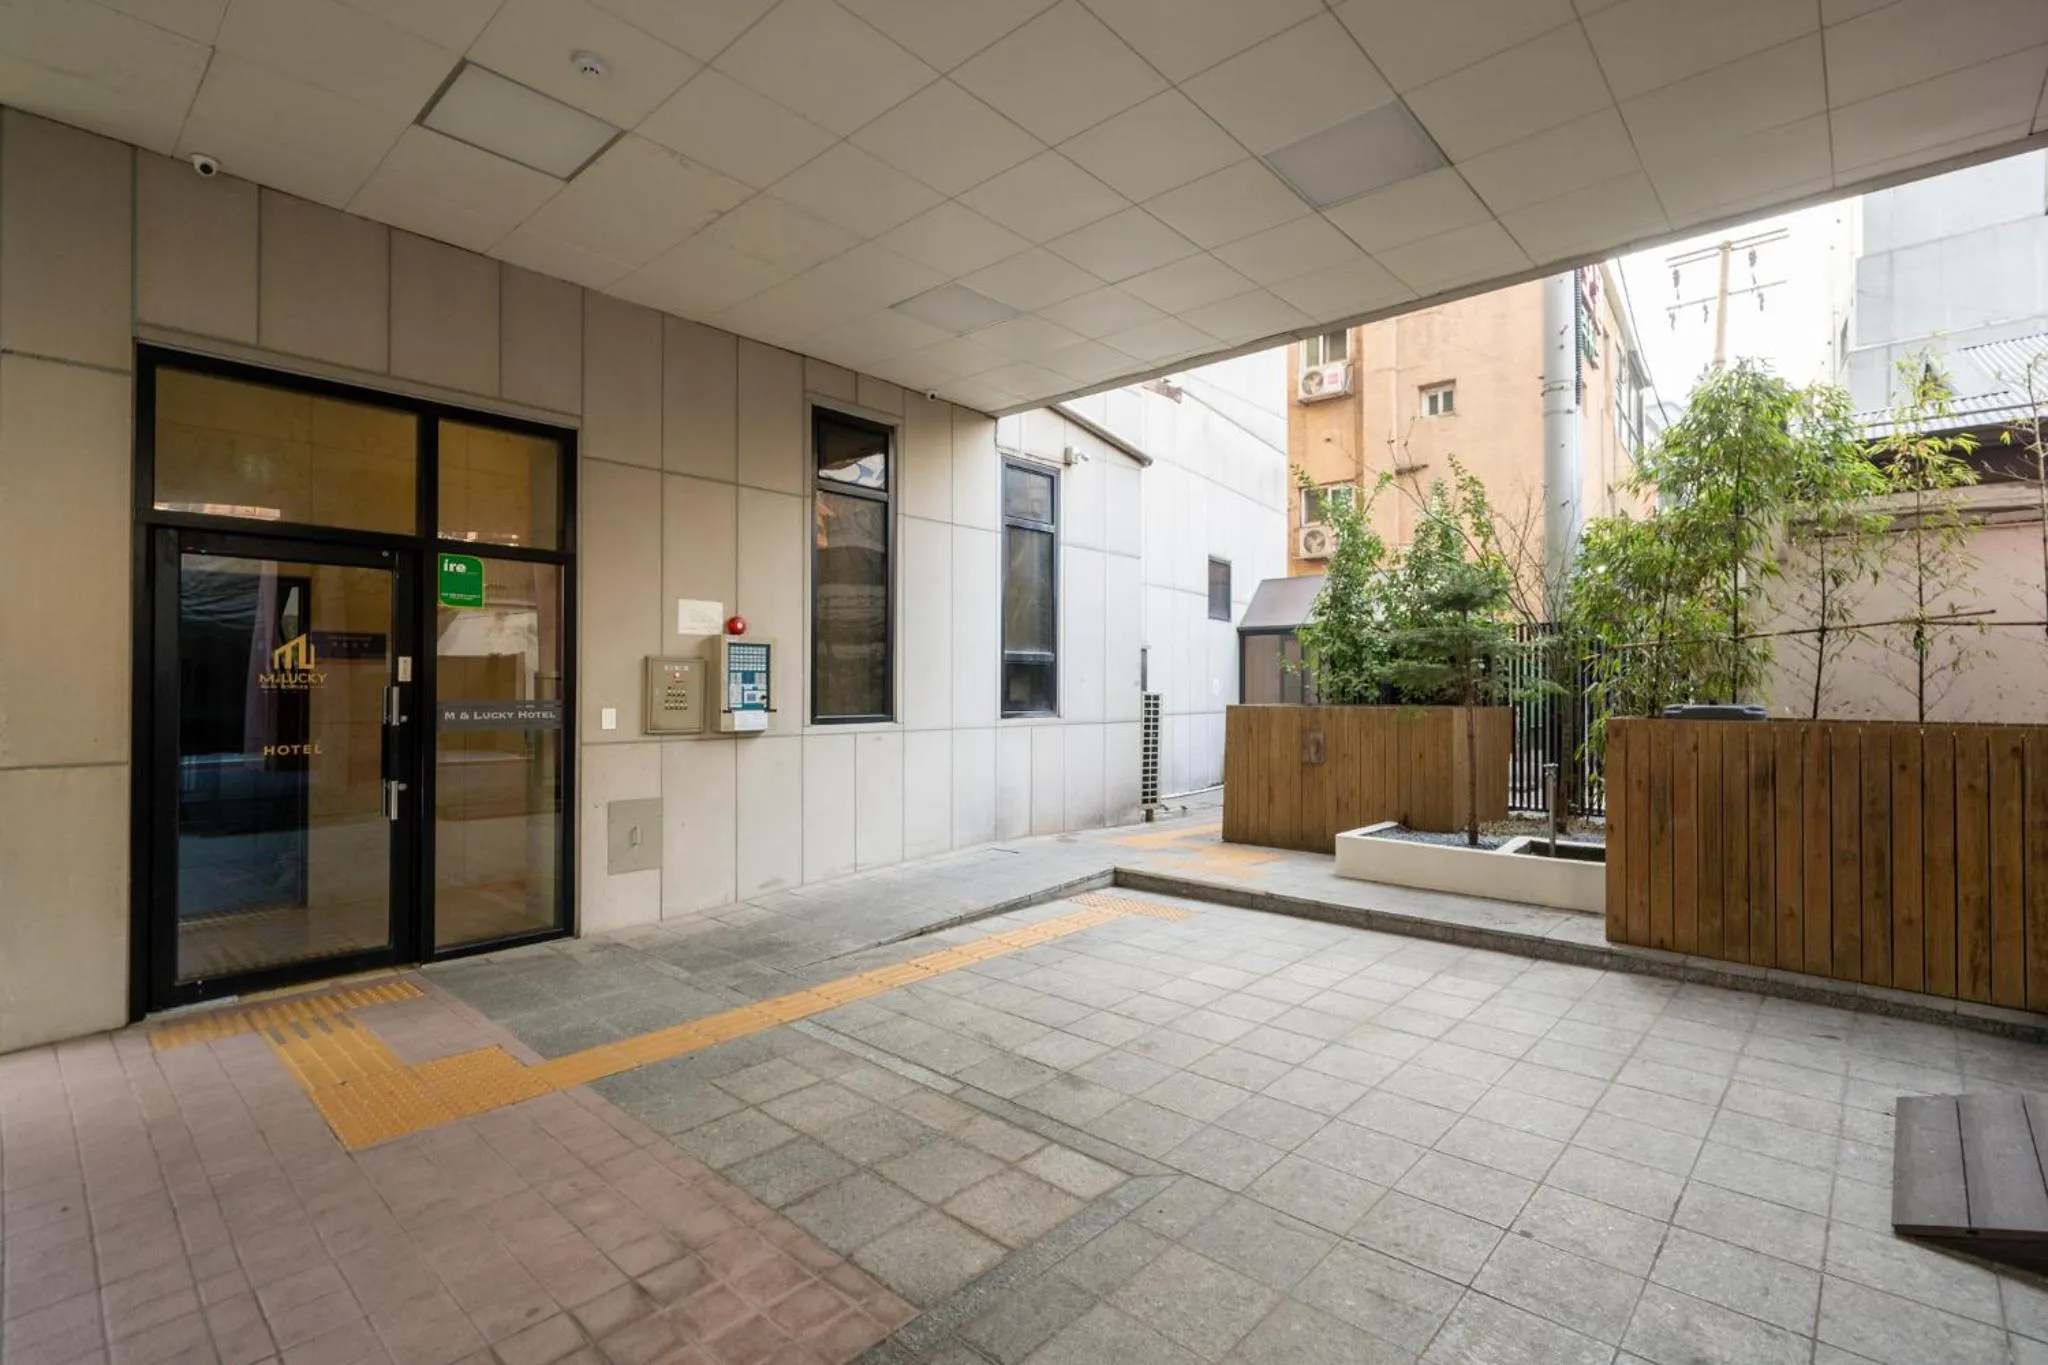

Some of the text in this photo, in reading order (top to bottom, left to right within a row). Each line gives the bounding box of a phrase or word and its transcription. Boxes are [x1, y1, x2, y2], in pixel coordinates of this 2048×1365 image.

[444, 711, 456, 721] M
[460, 711, 470, 720] &
[263, 743, 324, 756] HOTEL
